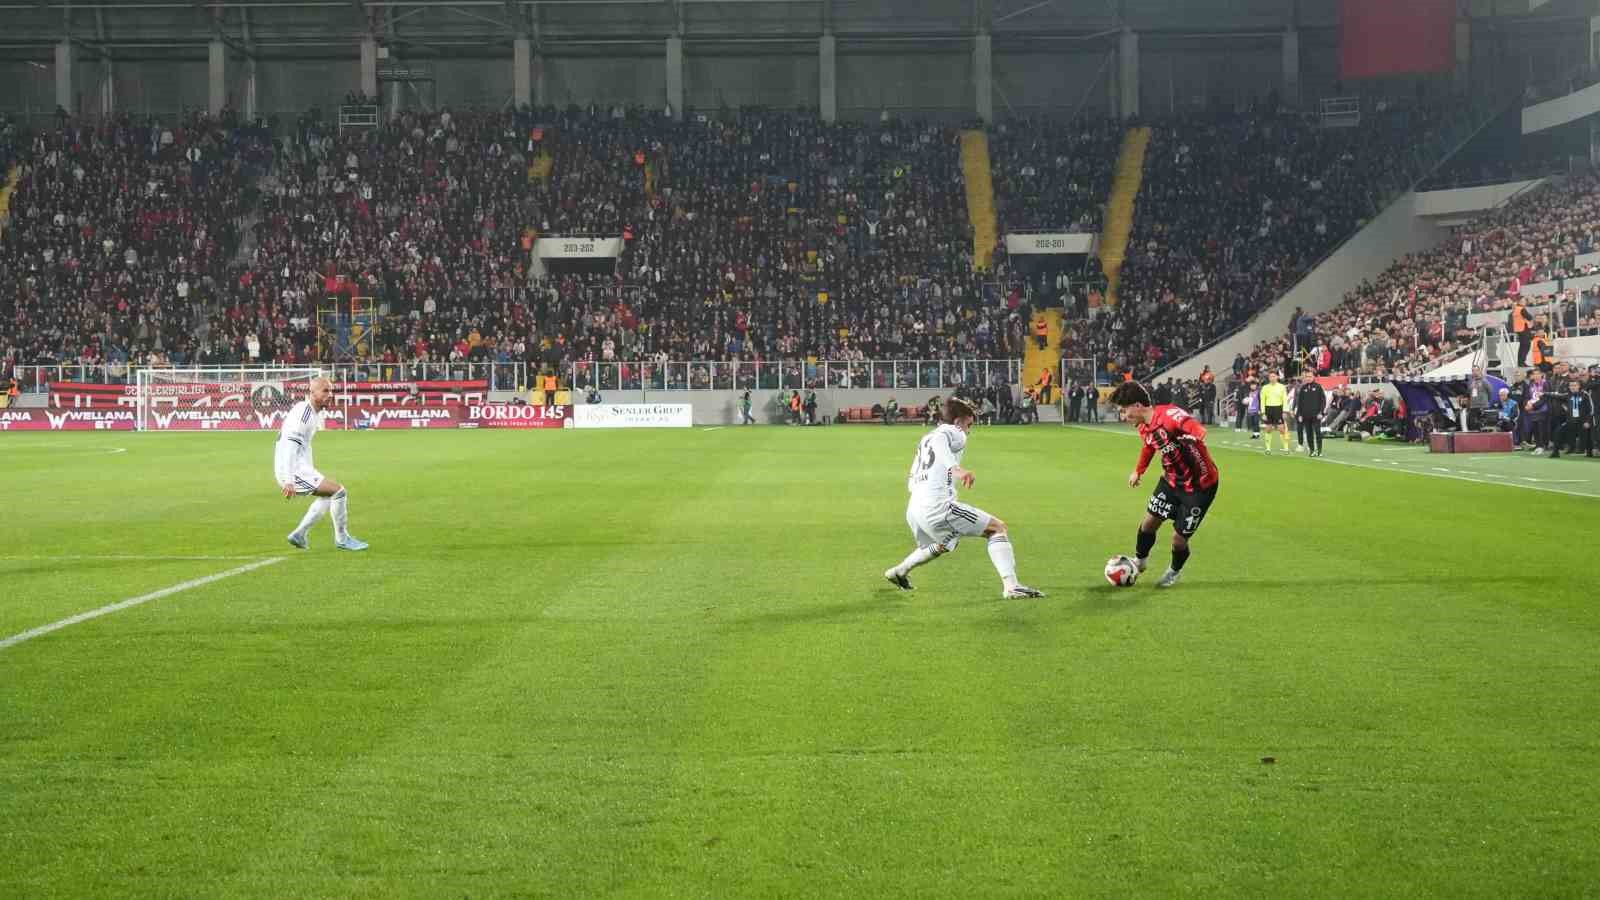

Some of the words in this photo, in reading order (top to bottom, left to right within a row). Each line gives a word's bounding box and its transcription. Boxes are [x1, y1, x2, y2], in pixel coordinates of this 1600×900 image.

[70, 411, 134, 420] WELLANA
[176, 411, 240, 420] WELLANA
[385, 410, 450, 419] WELLANA
[469, 406, 535, 419] BORDO
[541, 406, 564, 419] 145
